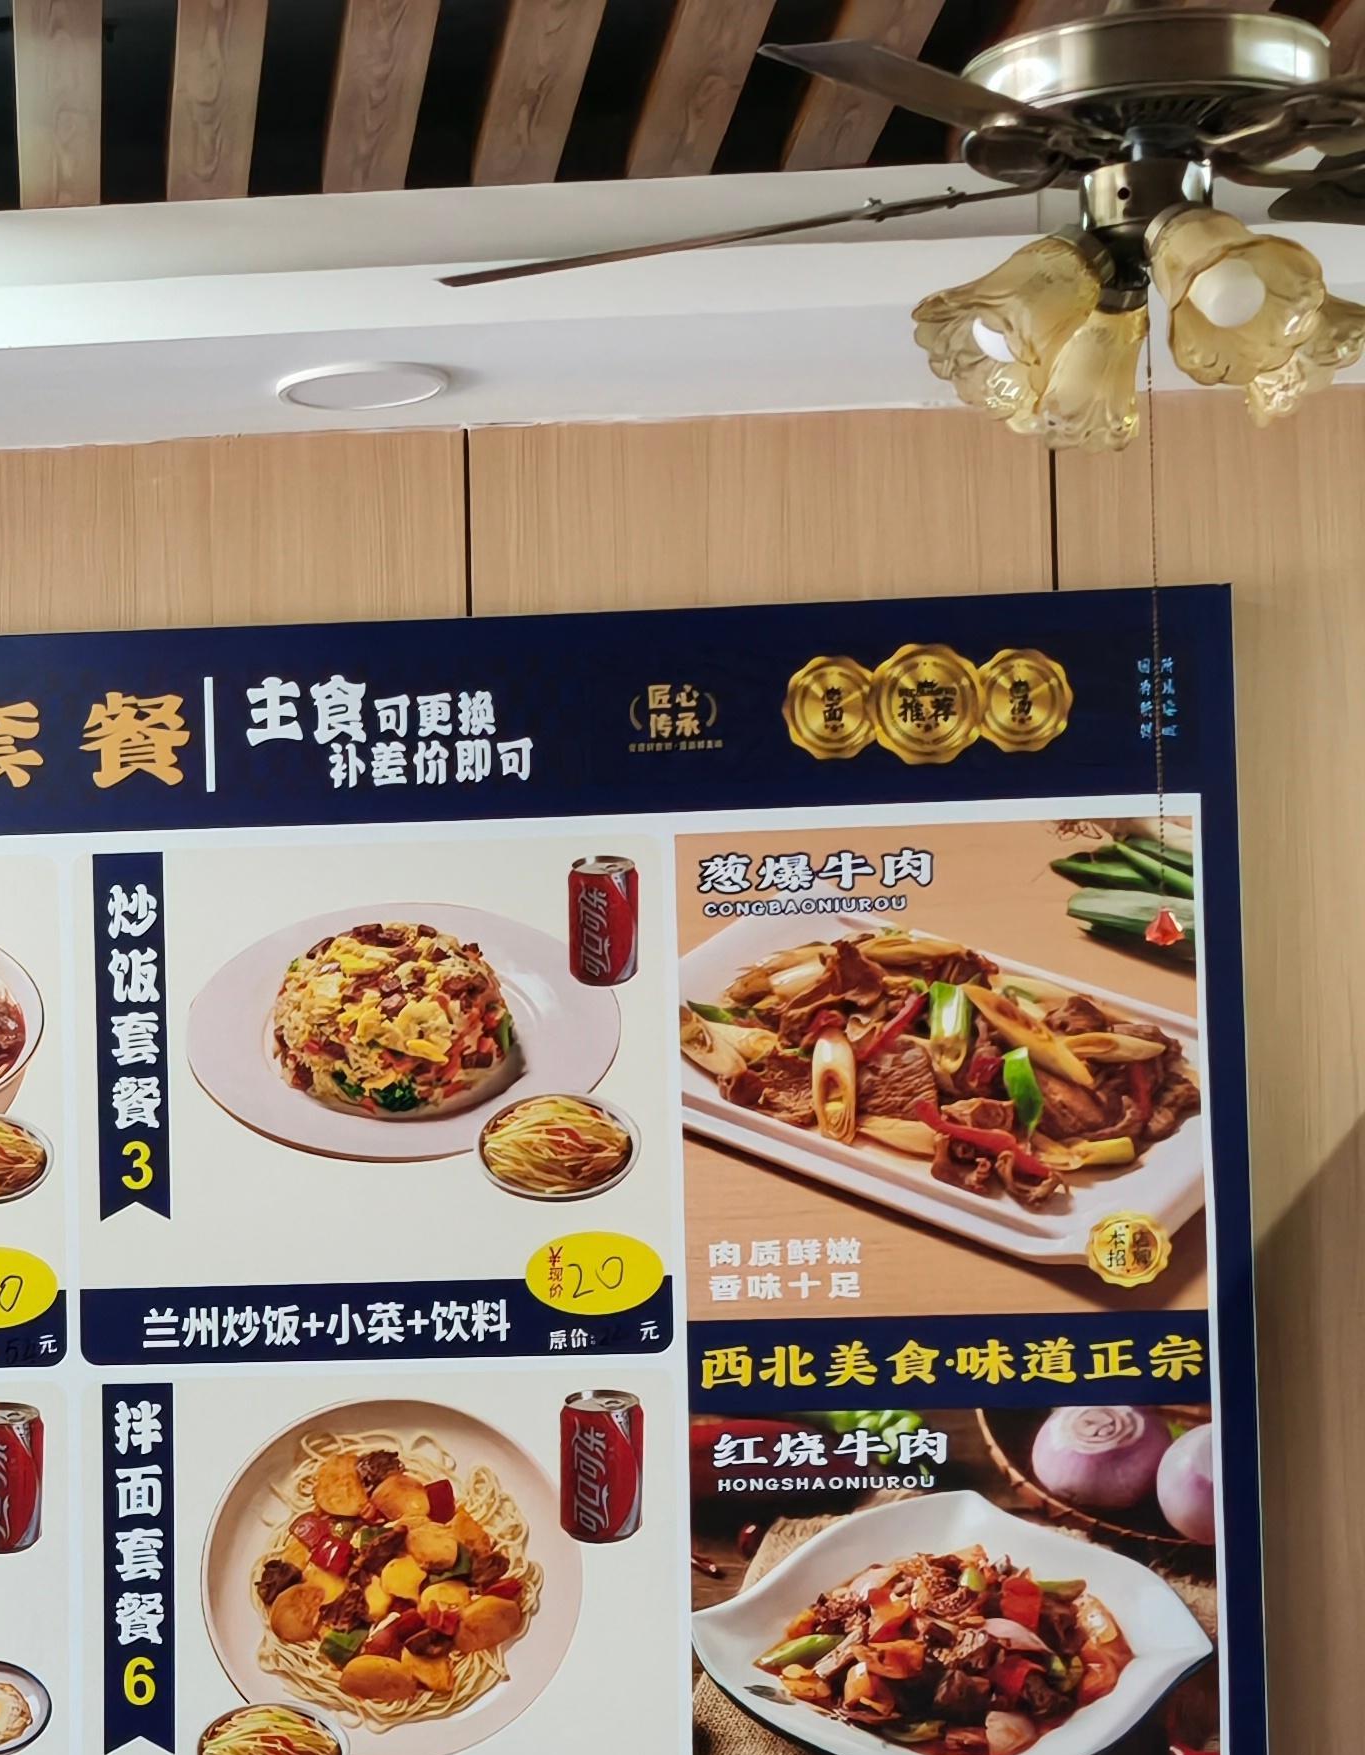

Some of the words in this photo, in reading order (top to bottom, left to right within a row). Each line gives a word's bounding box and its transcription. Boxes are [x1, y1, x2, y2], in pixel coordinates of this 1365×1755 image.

[329, 737, 534, 789] 补差价即可
[698, 849, 933, 895] 葱爆牛肉
[703, 895, 907, 917] CONGBAONIUROU
[708, 1238, 862, 1268] 肉质鲜嫩
[567, 1256, 625, 1299] 20
[708, 1271, 861, 1300] 香味十足
[142, 1299, 511, 1348] 兰州炒饭+小菜+饮料
[639, 1320, 660, 1341] 元
[39, 1335, 58, 1356] 元
[713, 1429, 948, 1469] 红烧牛肉
[717, 1475, 934, 1491] HONGSHAONIUROU
